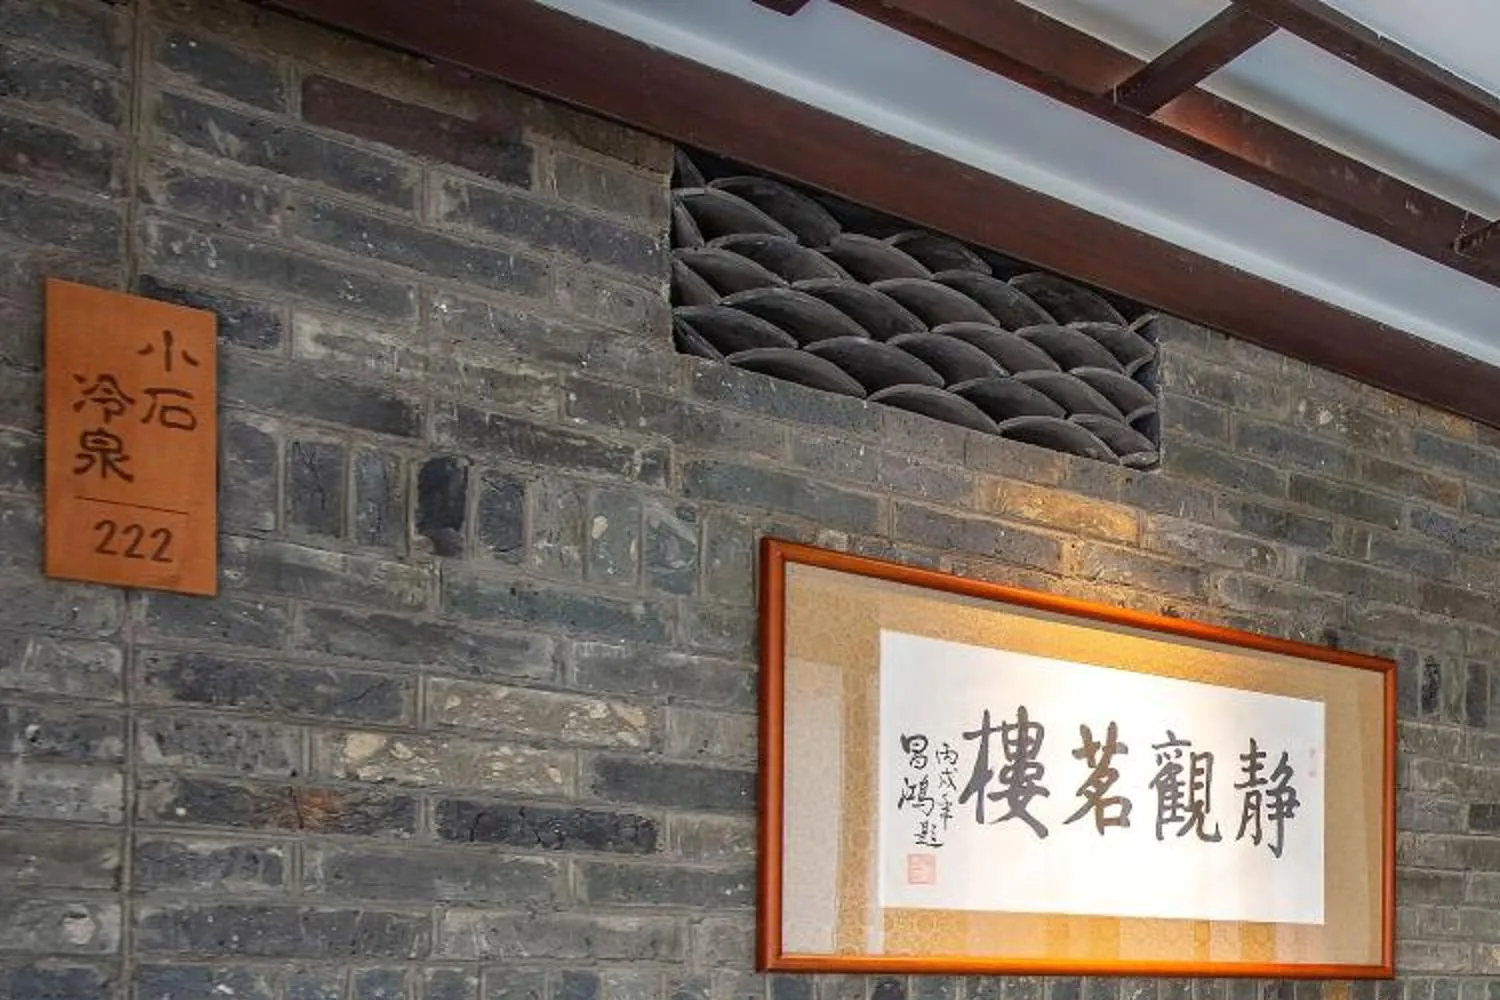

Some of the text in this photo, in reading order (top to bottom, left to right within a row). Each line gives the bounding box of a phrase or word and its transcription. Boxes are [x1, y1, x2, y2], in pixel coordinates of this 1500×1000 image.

[72, 373, 135, 482] 冷泉
[138, 330, 199, 431] 小石
[94, 519, 174, 563] 222
